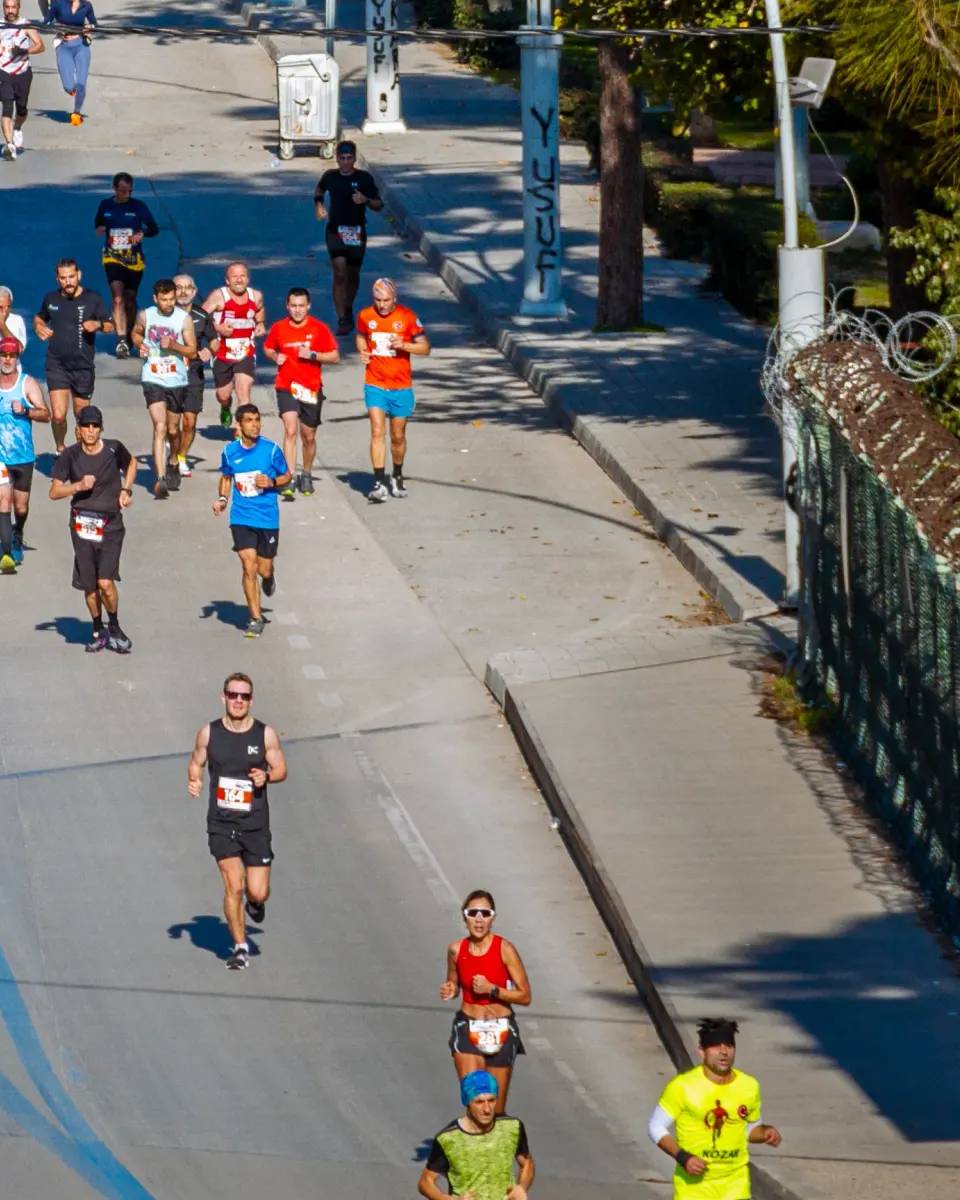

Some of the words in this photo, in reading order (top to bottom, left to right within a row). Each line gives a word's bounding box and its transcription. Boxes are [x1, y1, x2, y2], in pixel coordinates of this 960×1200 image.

[527, 107, 558, 293] YUSUF
[224, 787, 244, 803] 164
[478, 1031, 500, 1045] 281
